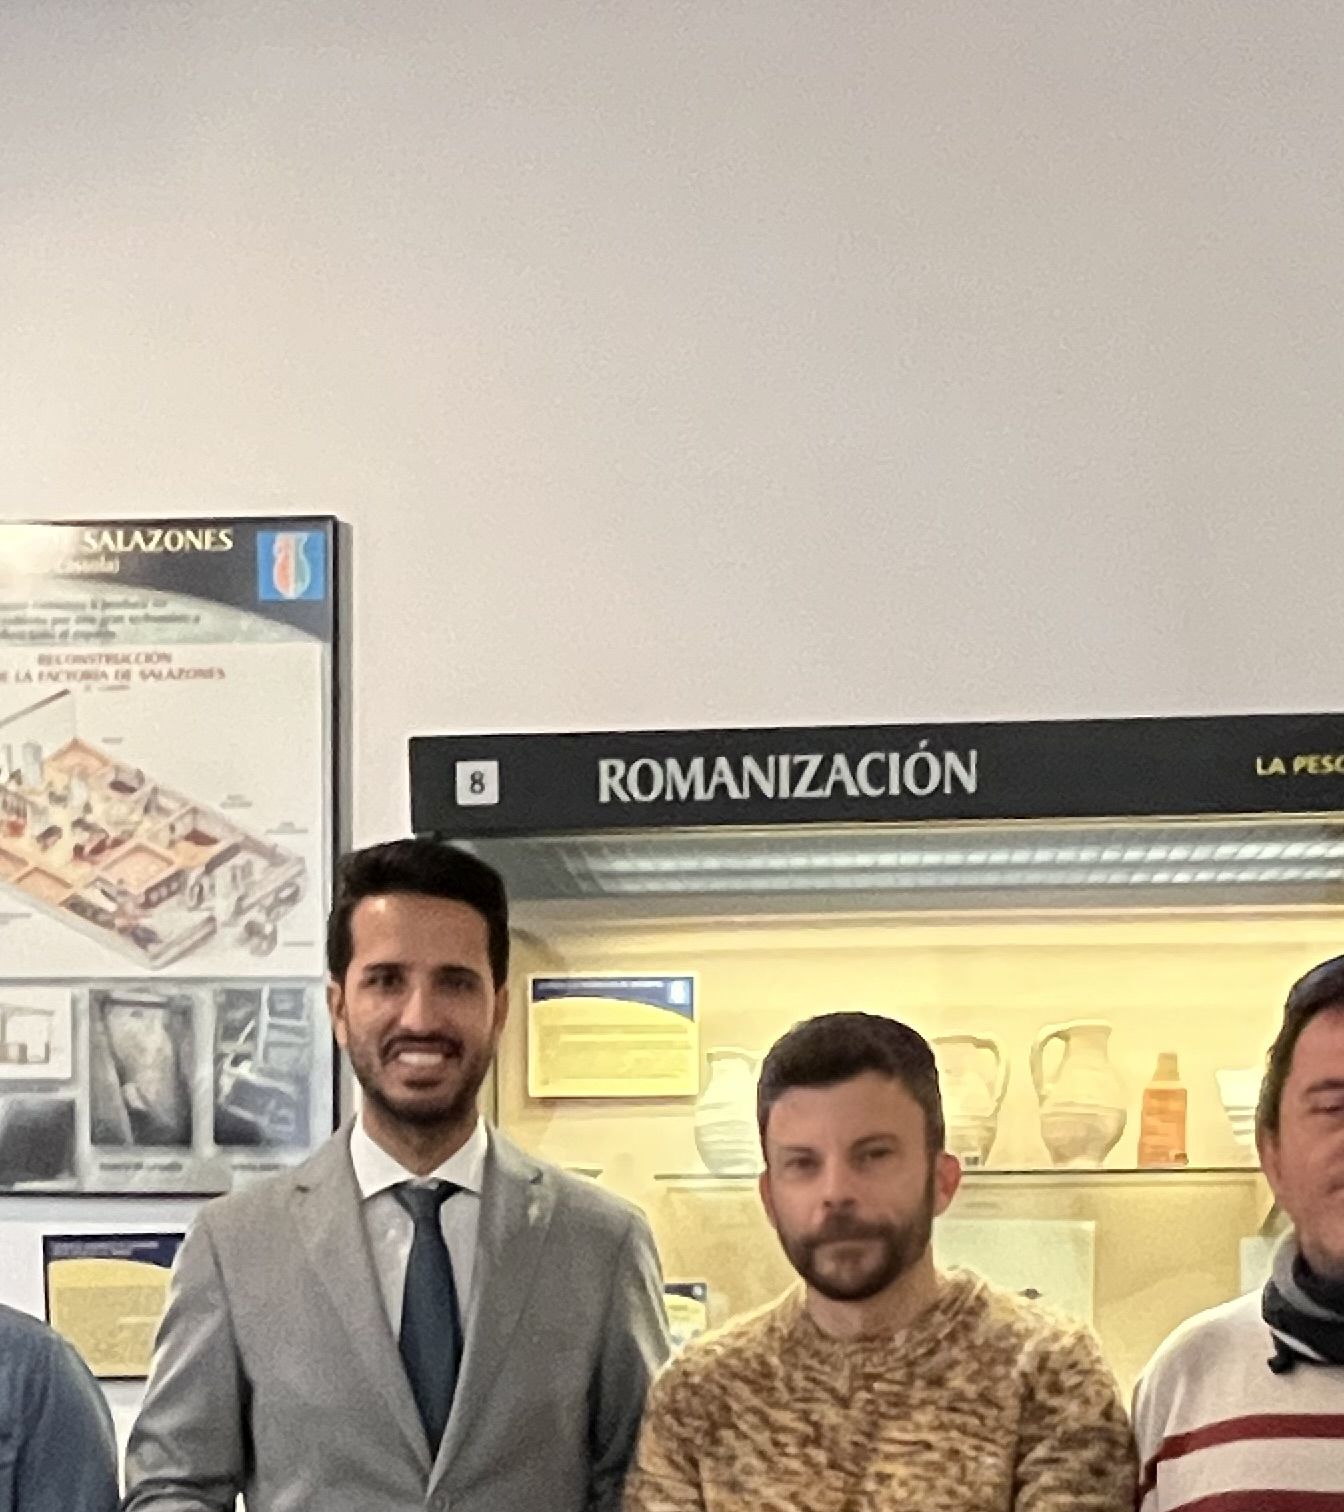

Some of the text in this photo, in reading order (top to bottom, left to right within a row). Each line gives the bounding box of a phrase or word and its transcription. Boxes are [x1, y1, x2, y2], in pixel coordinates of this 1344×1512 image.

[84, 527, 234, 552] SALAZONES
[15, 669, 33, 683] LA
[114, 668, 132, 681] DE
[139, 667, 226, 681] SALAZONES
[598, 739, 978, 802] ROMANIZACIÓN
[1256, 757, 1286, 776] LA
[469, 770, 486, 795] 8
